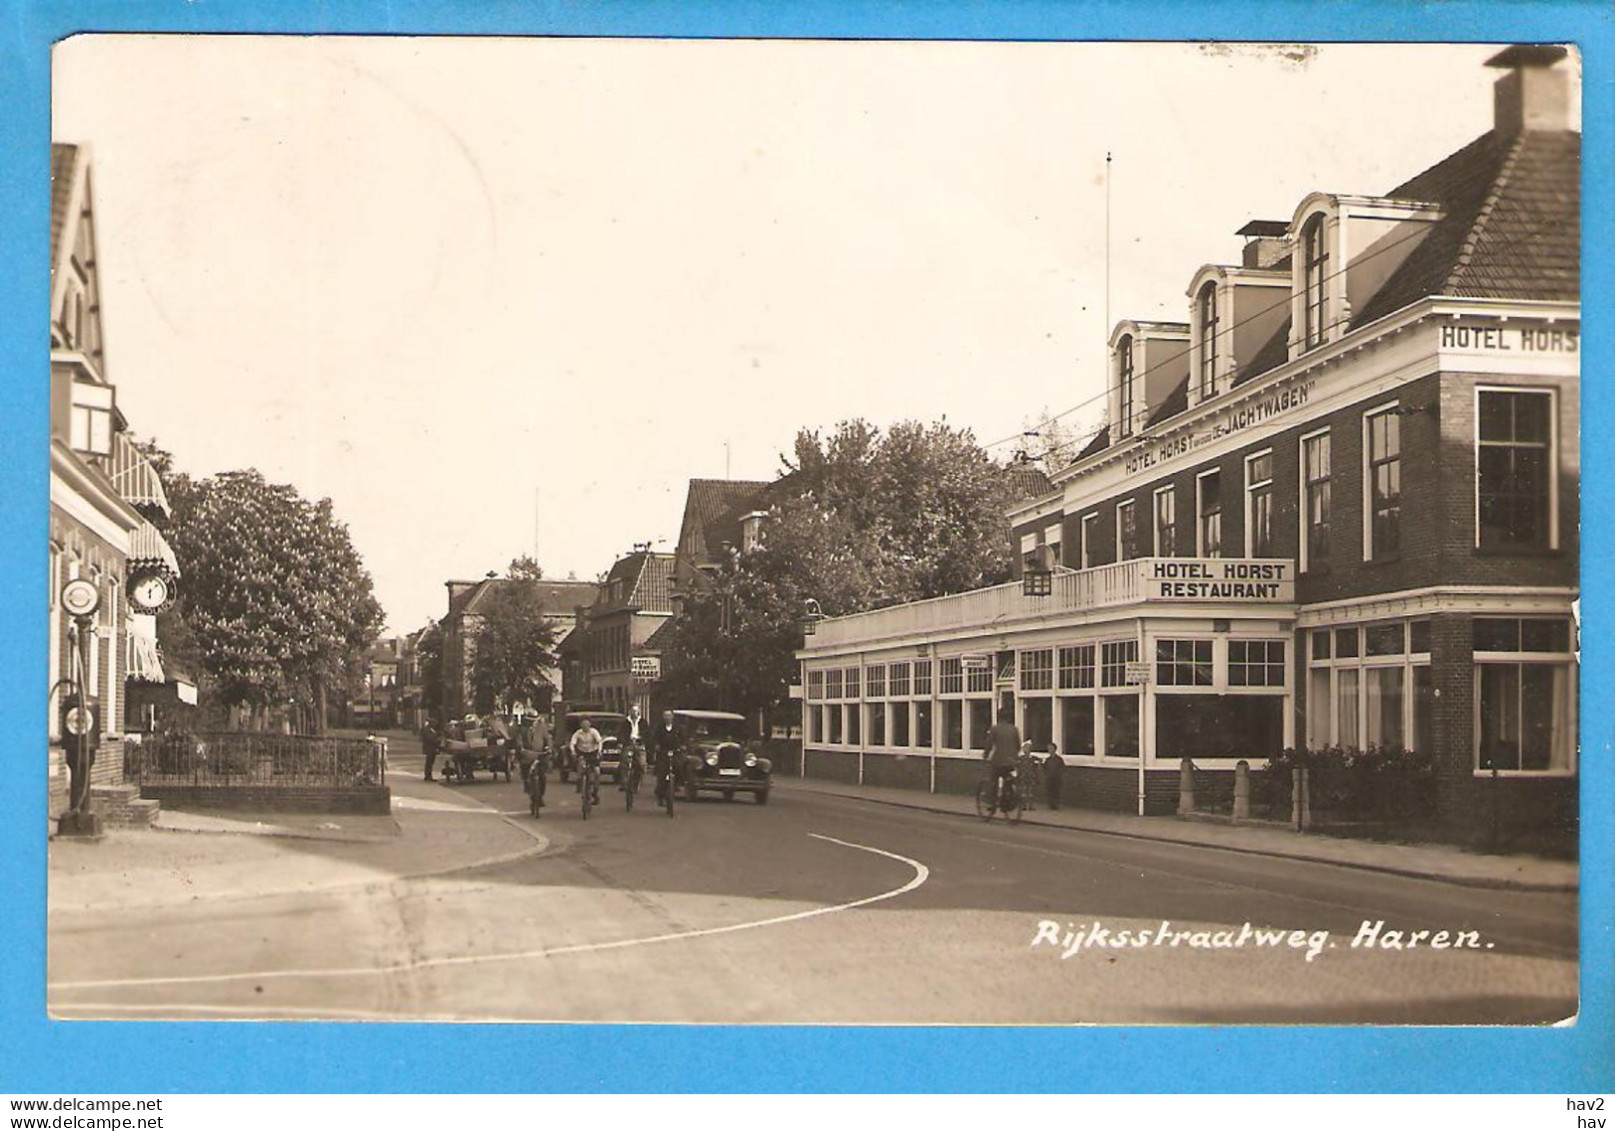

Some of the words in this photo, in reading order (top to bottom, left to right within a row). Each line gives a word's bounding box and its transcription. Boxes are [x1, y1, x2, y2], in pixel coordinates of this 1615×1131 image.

[1442, 326, 1510, 350] HOTEL
[1126, 450, 1156, 476] HOTEL
[1160, 433, 1194, 461] HORST
[1154, 563, 1214, 578] HOTEL
[1224, 564, 1285, 579] HORST
[1161, 582, 1280, 598] RESTAURANT
